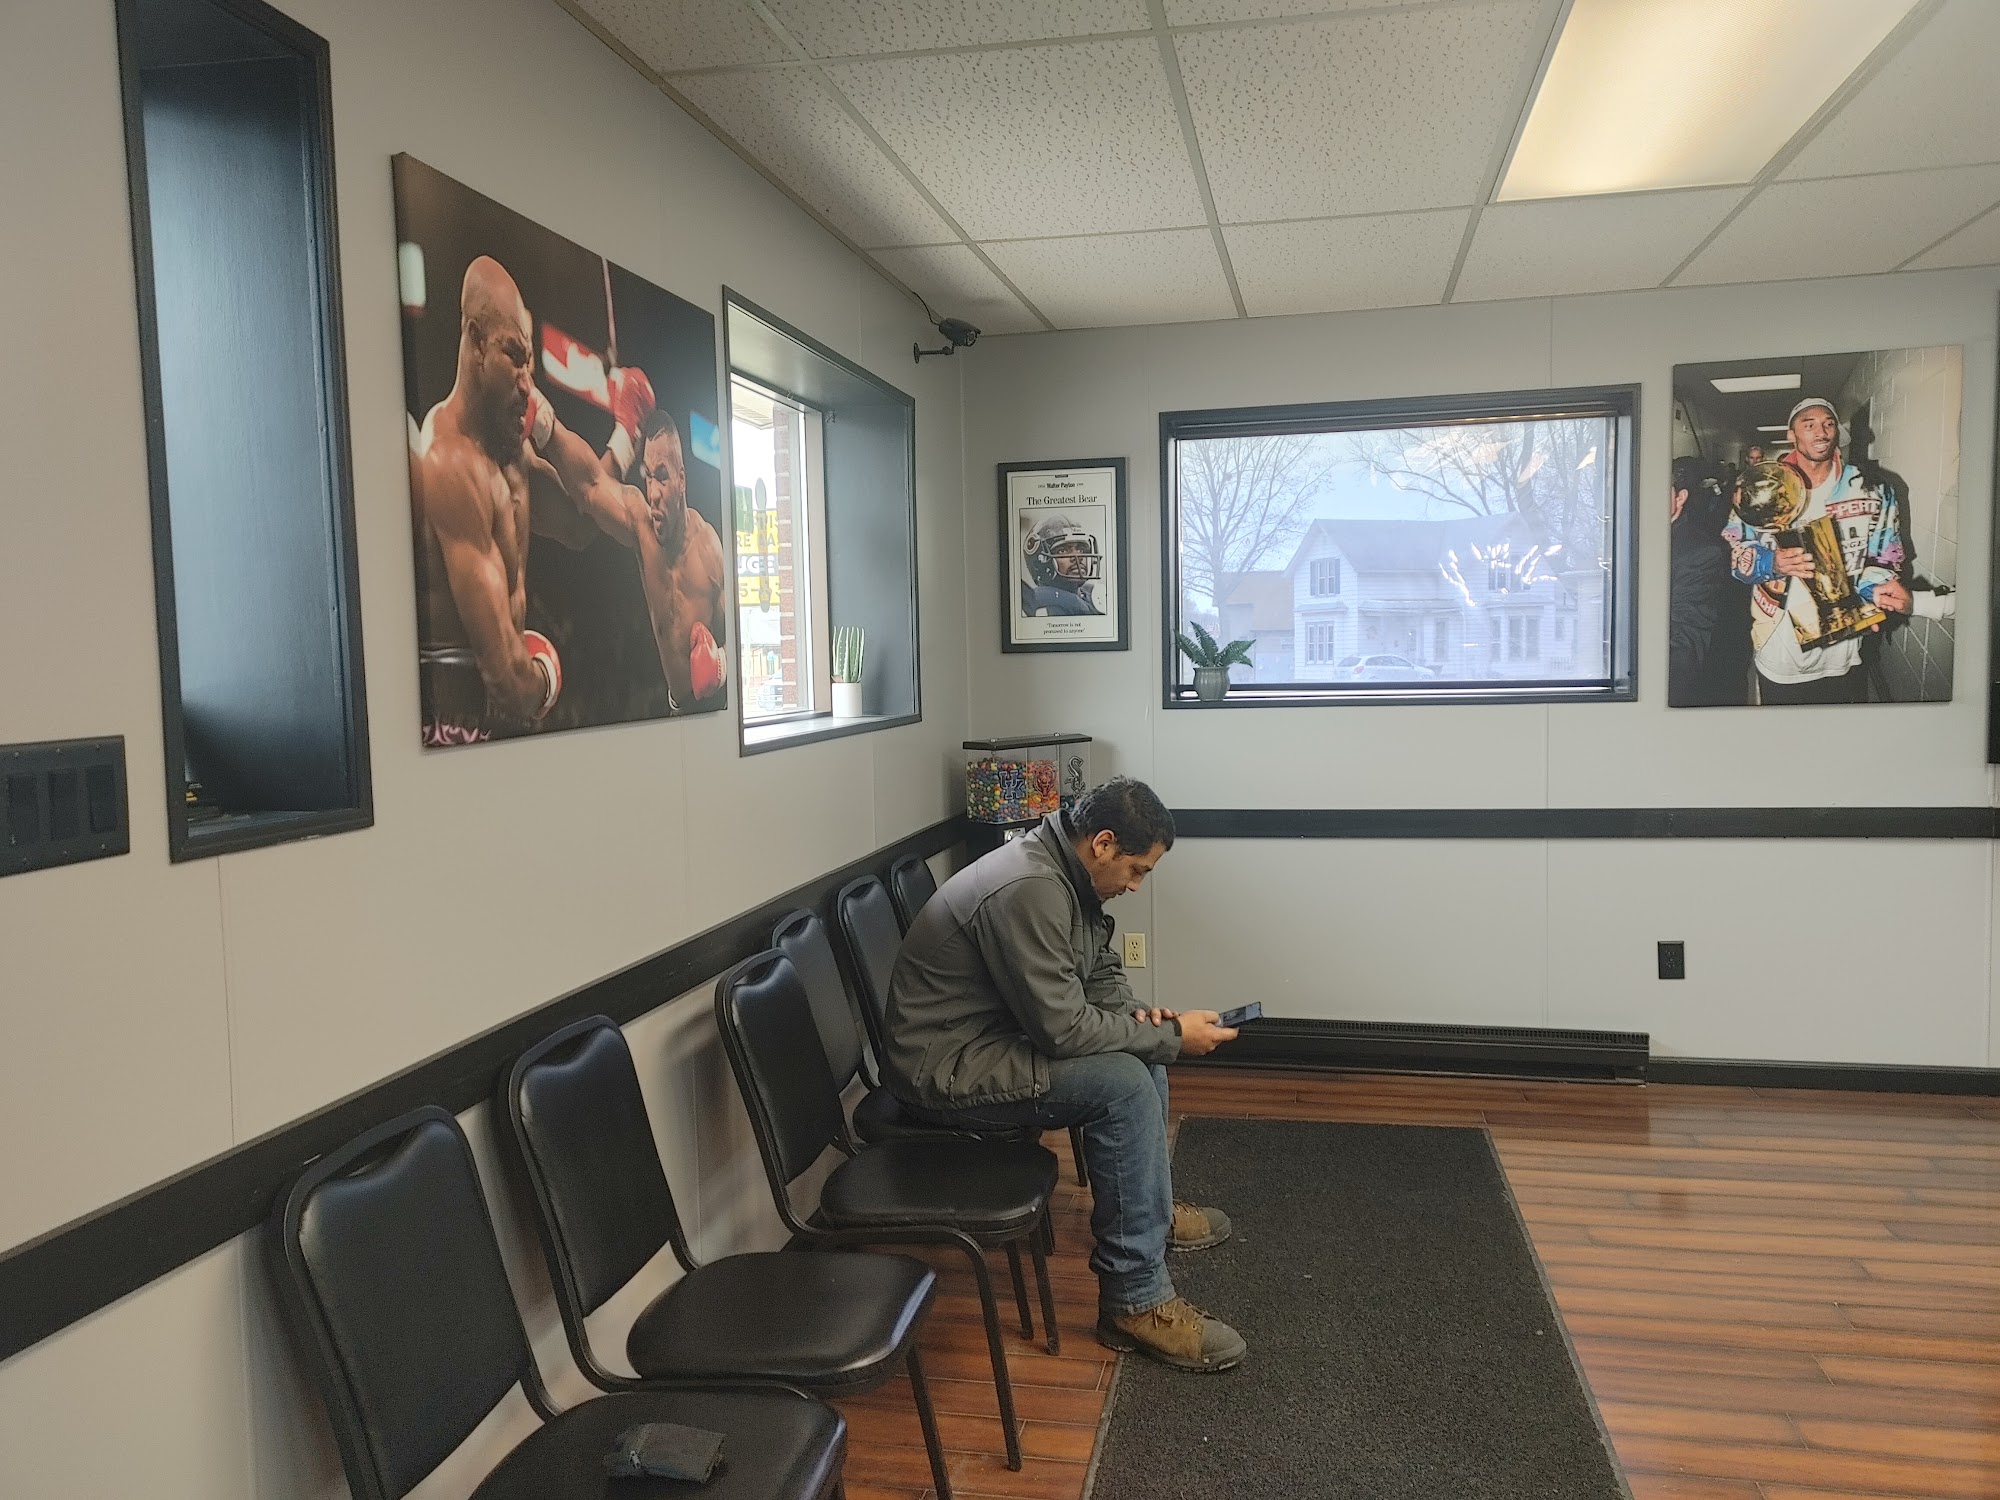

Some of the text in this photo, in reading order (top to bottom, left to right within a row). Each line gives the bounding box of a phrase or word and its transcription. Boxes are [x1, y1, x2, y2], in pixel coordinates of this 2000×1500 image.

[1026, 494, 1098, 506] The Greatest Bear
